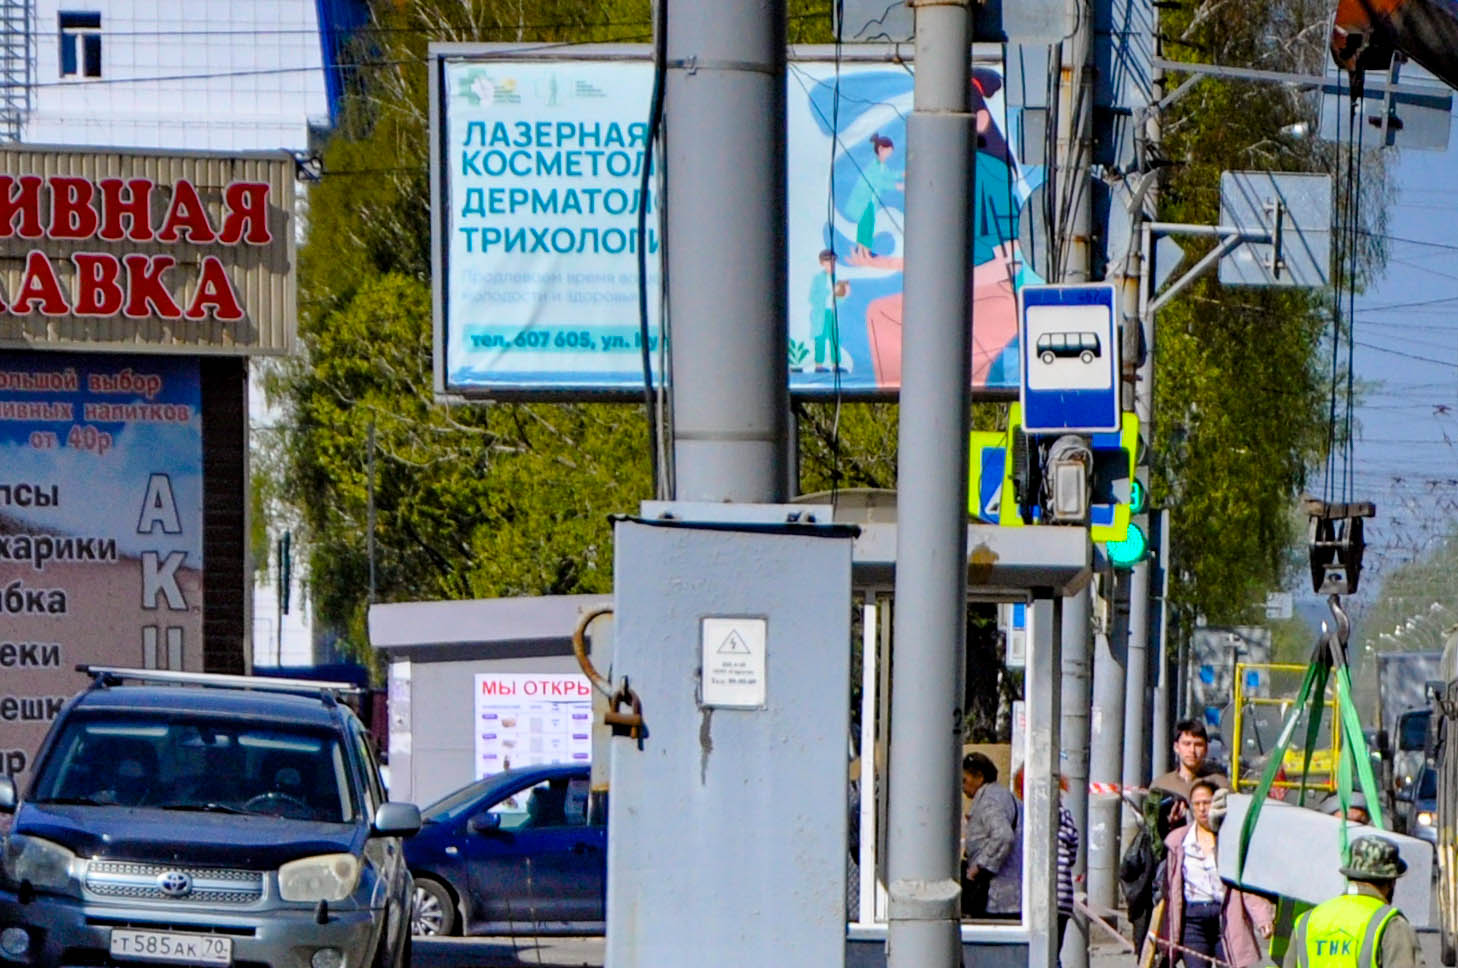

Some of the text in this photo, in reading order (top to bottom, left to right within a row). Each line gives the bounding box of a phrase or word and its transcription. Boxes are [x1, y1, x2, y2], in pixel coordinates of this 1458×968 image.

[463, 121, 648, 148] ЛАЗЕРНАЯ
[0, 250, 245, 321] АВКА
[88, 369, 163, 400] выбор
[84, 402, 191, 422] напитков
[29, 425, 113, 455] от 40р
[0, 580, 67, 613] бка
[482, 680, 516, 695] МЫ
